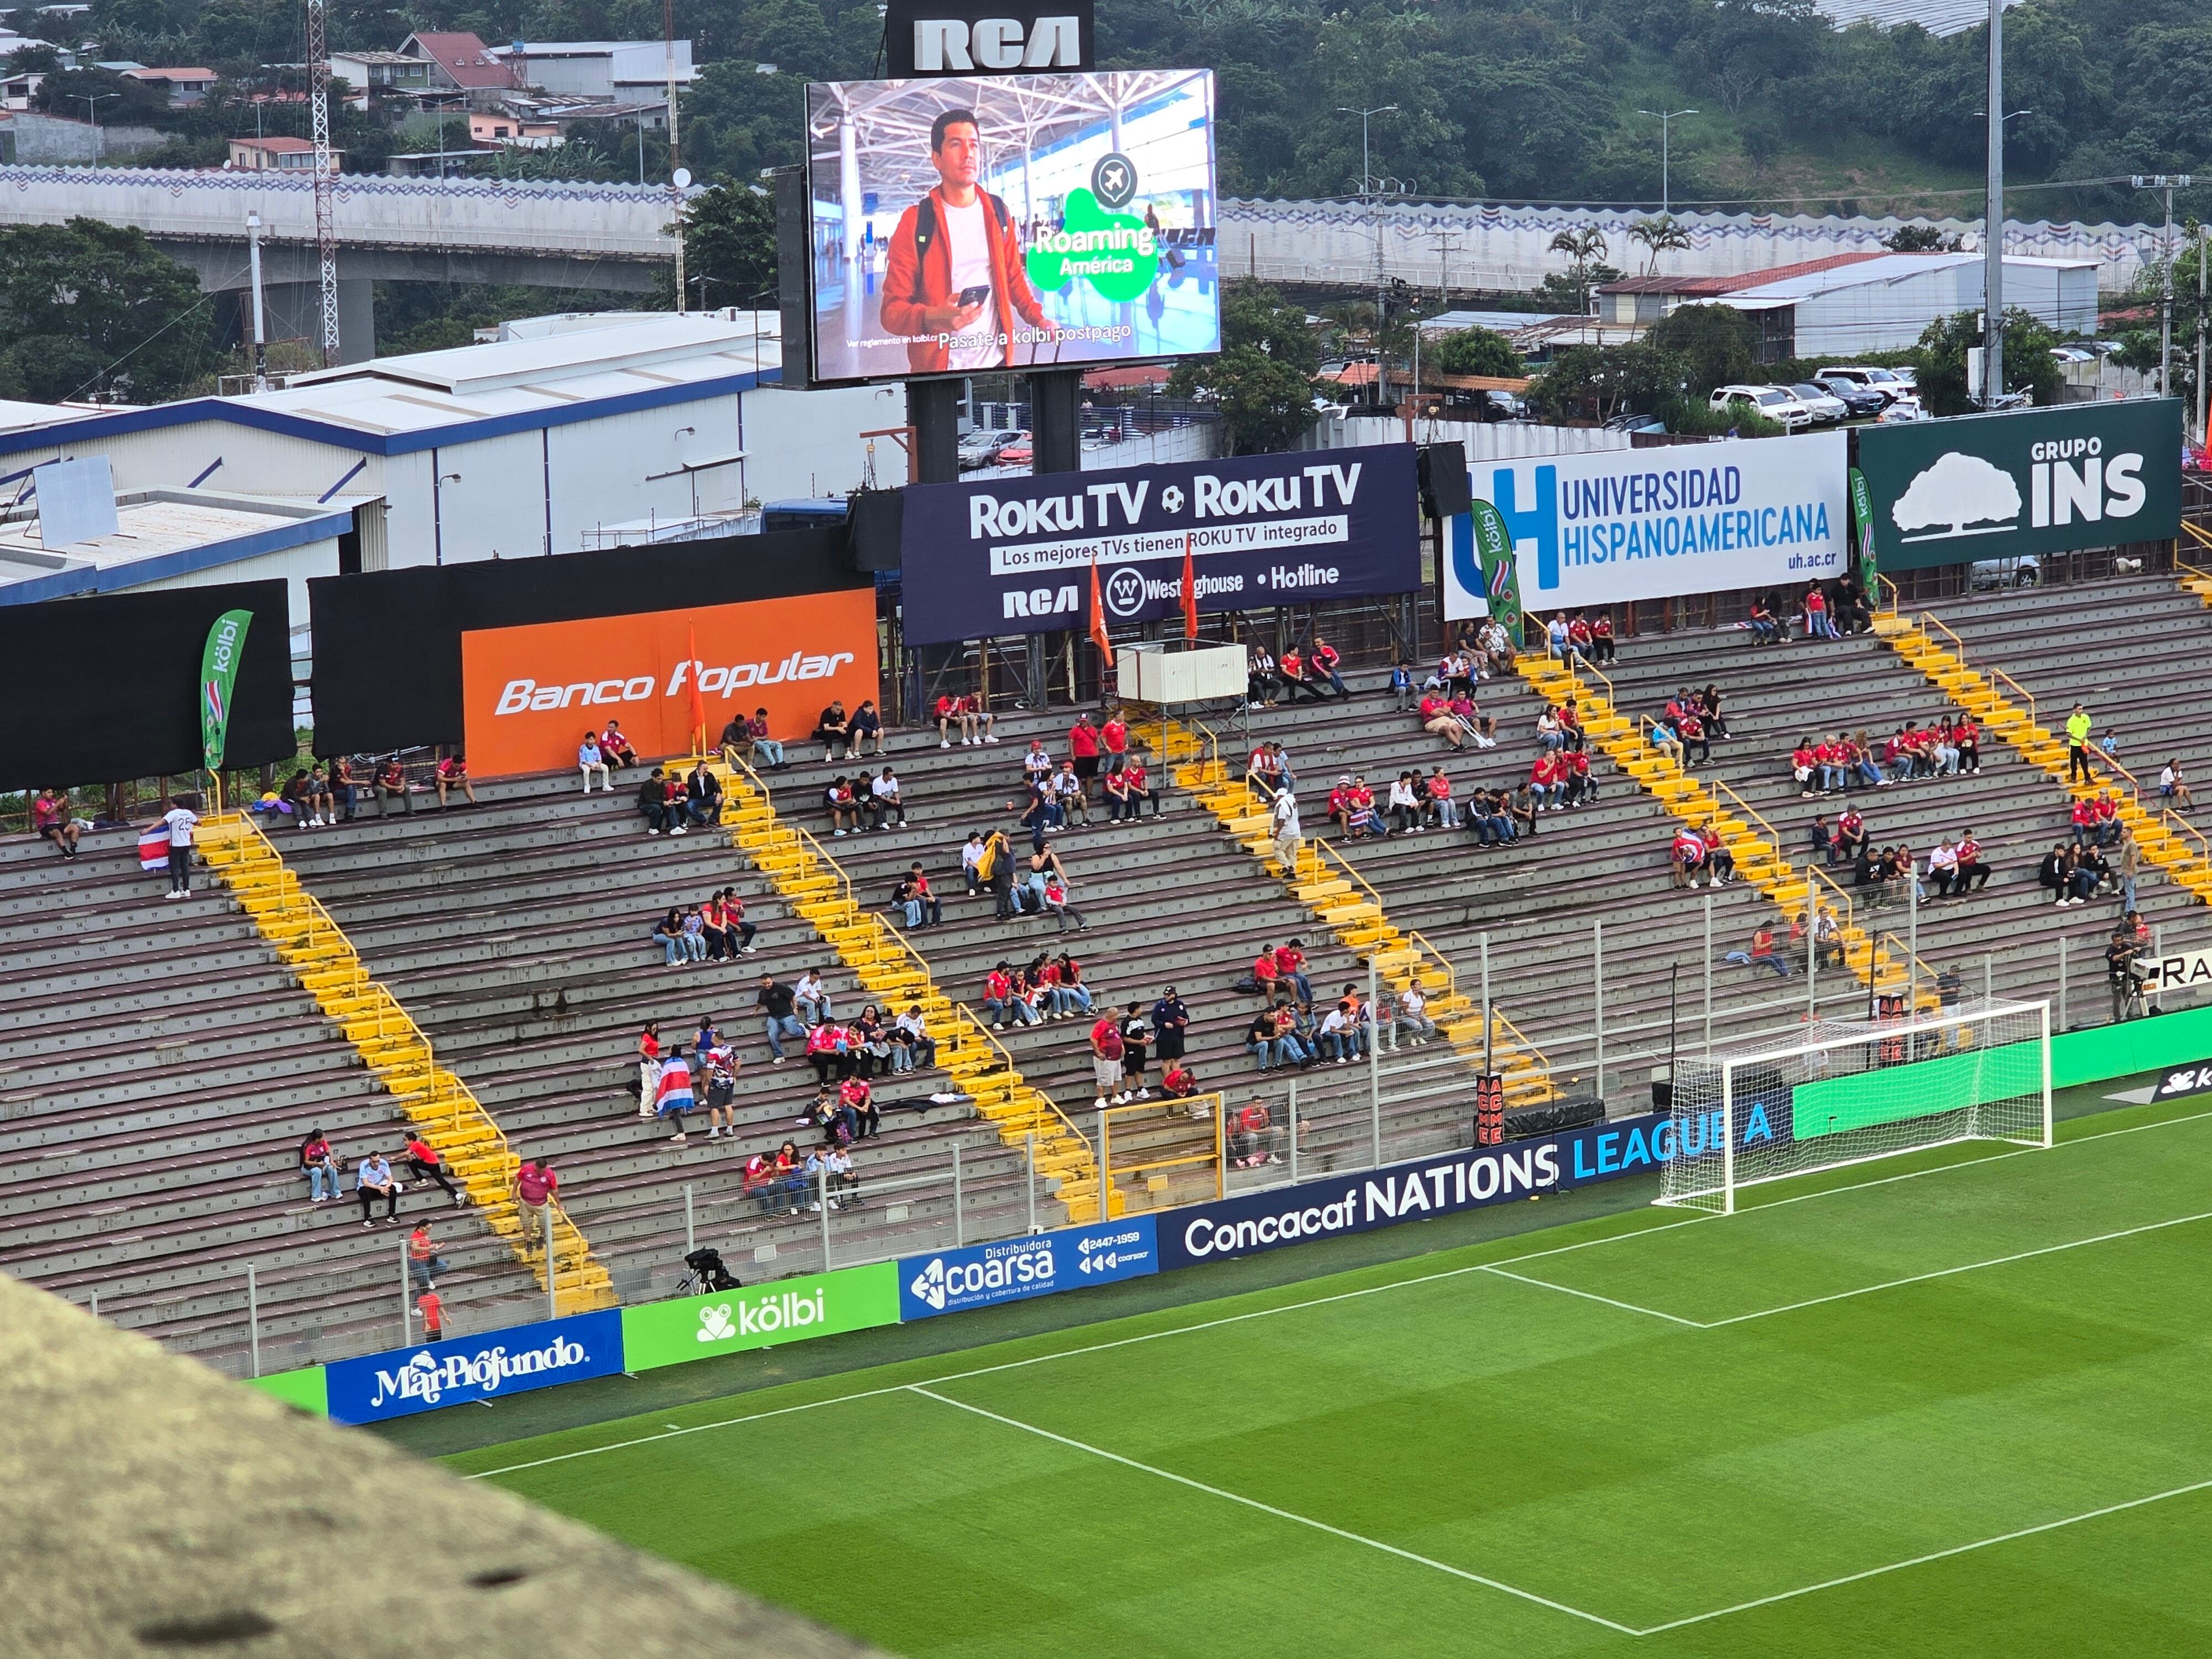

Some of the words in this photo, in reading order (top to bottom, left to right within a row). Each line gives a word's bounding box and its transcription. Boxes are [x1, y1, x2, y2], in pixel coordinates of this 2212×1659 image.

[914, 16, 1080, 71] RCA
[1036, 221, 1154, 256] Roaming
[1060, 254, 1133, 276] América
[846, 339, 859, 348] Ver
[860, 337, 900, 348] reglamento
[939, 332, 994, 349] Pasate
[998, 333, 1008, 345] a
[1013, 326, 1050, 343] kölbi
[1055, 325, 1131, 346] postpago
[2031, 436, 2102, 461] GRUPO
[1087, 480, 1150, 527] TV
[1303, 463, 1361, 507] TV
[1562, 466, 1740, 520] UNIVERSIDAD
[2032, 452, 2146, 528] INS
[1003, 550, 1030, 566] Los
[1034, 545, 1098, 565] mejores
[1102, 539, 1130, 555] TVs
[1134, 537, 1183, 552] tienen
[1190, 529, 1232, 548] ROKU
[1235, 527, 1256, 542] TV
[1264, 520, 1337, 542] integrado
[1480, 509, 1503, 554] kölbi
[1564, 502, 1830, 567] HISPANOAMERICANA
[1788, 552, 1837, 570] uh.ac.cr
[1003, 585, 1078, 619] RCA
[1146, 574, 1244, 600] Westghouse
[1272, 564, 1339, 589] Hotline
[212, 618, 238, 673] kölbi
[494, 675, 655, 716] Banco
[665, 650, 854, 698] Popular
[178, 817, 191, 831] 25
[1185, 1188, 1357, 1257] Concacaf
[1365, 1144, 1559, 1222] NATIONS
[1744, 1103, 1772, 1143] A
[985, 1239, 1051, 1259] Distribuidora
[1089, 1232, 1140, 1250] 2447-1959
[946, 1250, 1054, 1295] coarsa
[948, 1293, 984, 1306] distribución
[992, 1287, 1021, 1297] cobertura
[1031, 1280, 1053, 1290] calidad
[739, 1288, 824, 1336] kölbi
